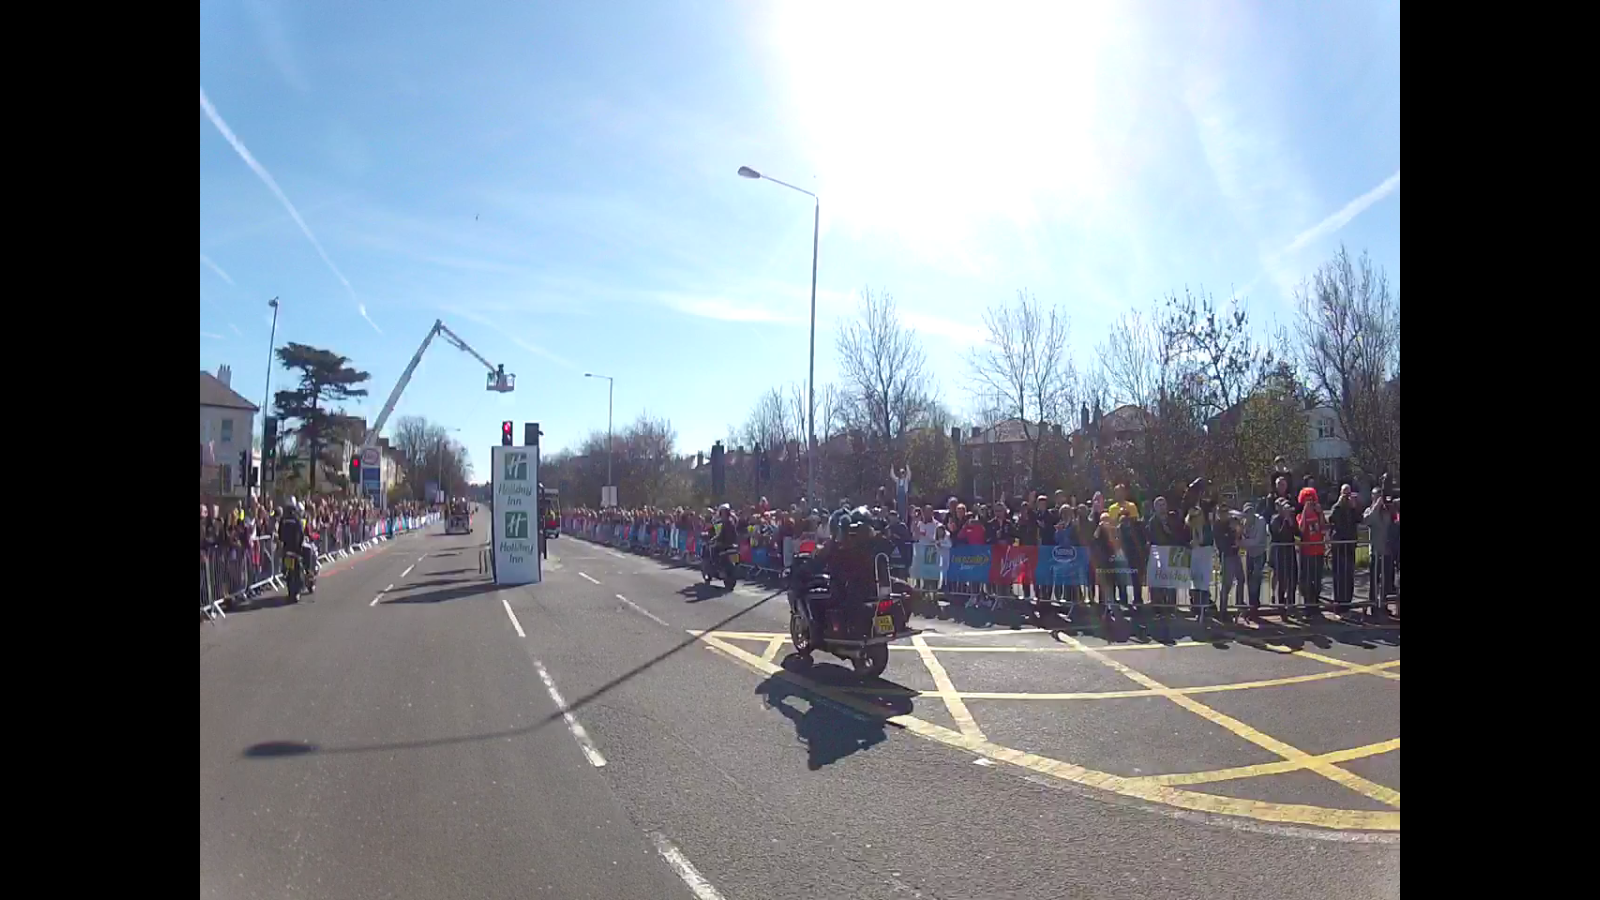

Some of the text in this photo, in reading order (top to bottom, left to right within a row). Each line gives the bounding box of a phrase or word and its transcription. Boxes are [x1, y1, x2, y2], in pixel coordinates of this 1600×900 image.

[498, 483, 533, 496] Holiday
[507, 495, 522, 506] Inn
[500, 541, 534, 556] Holiday
[509, 554, 524, 564] Inn
